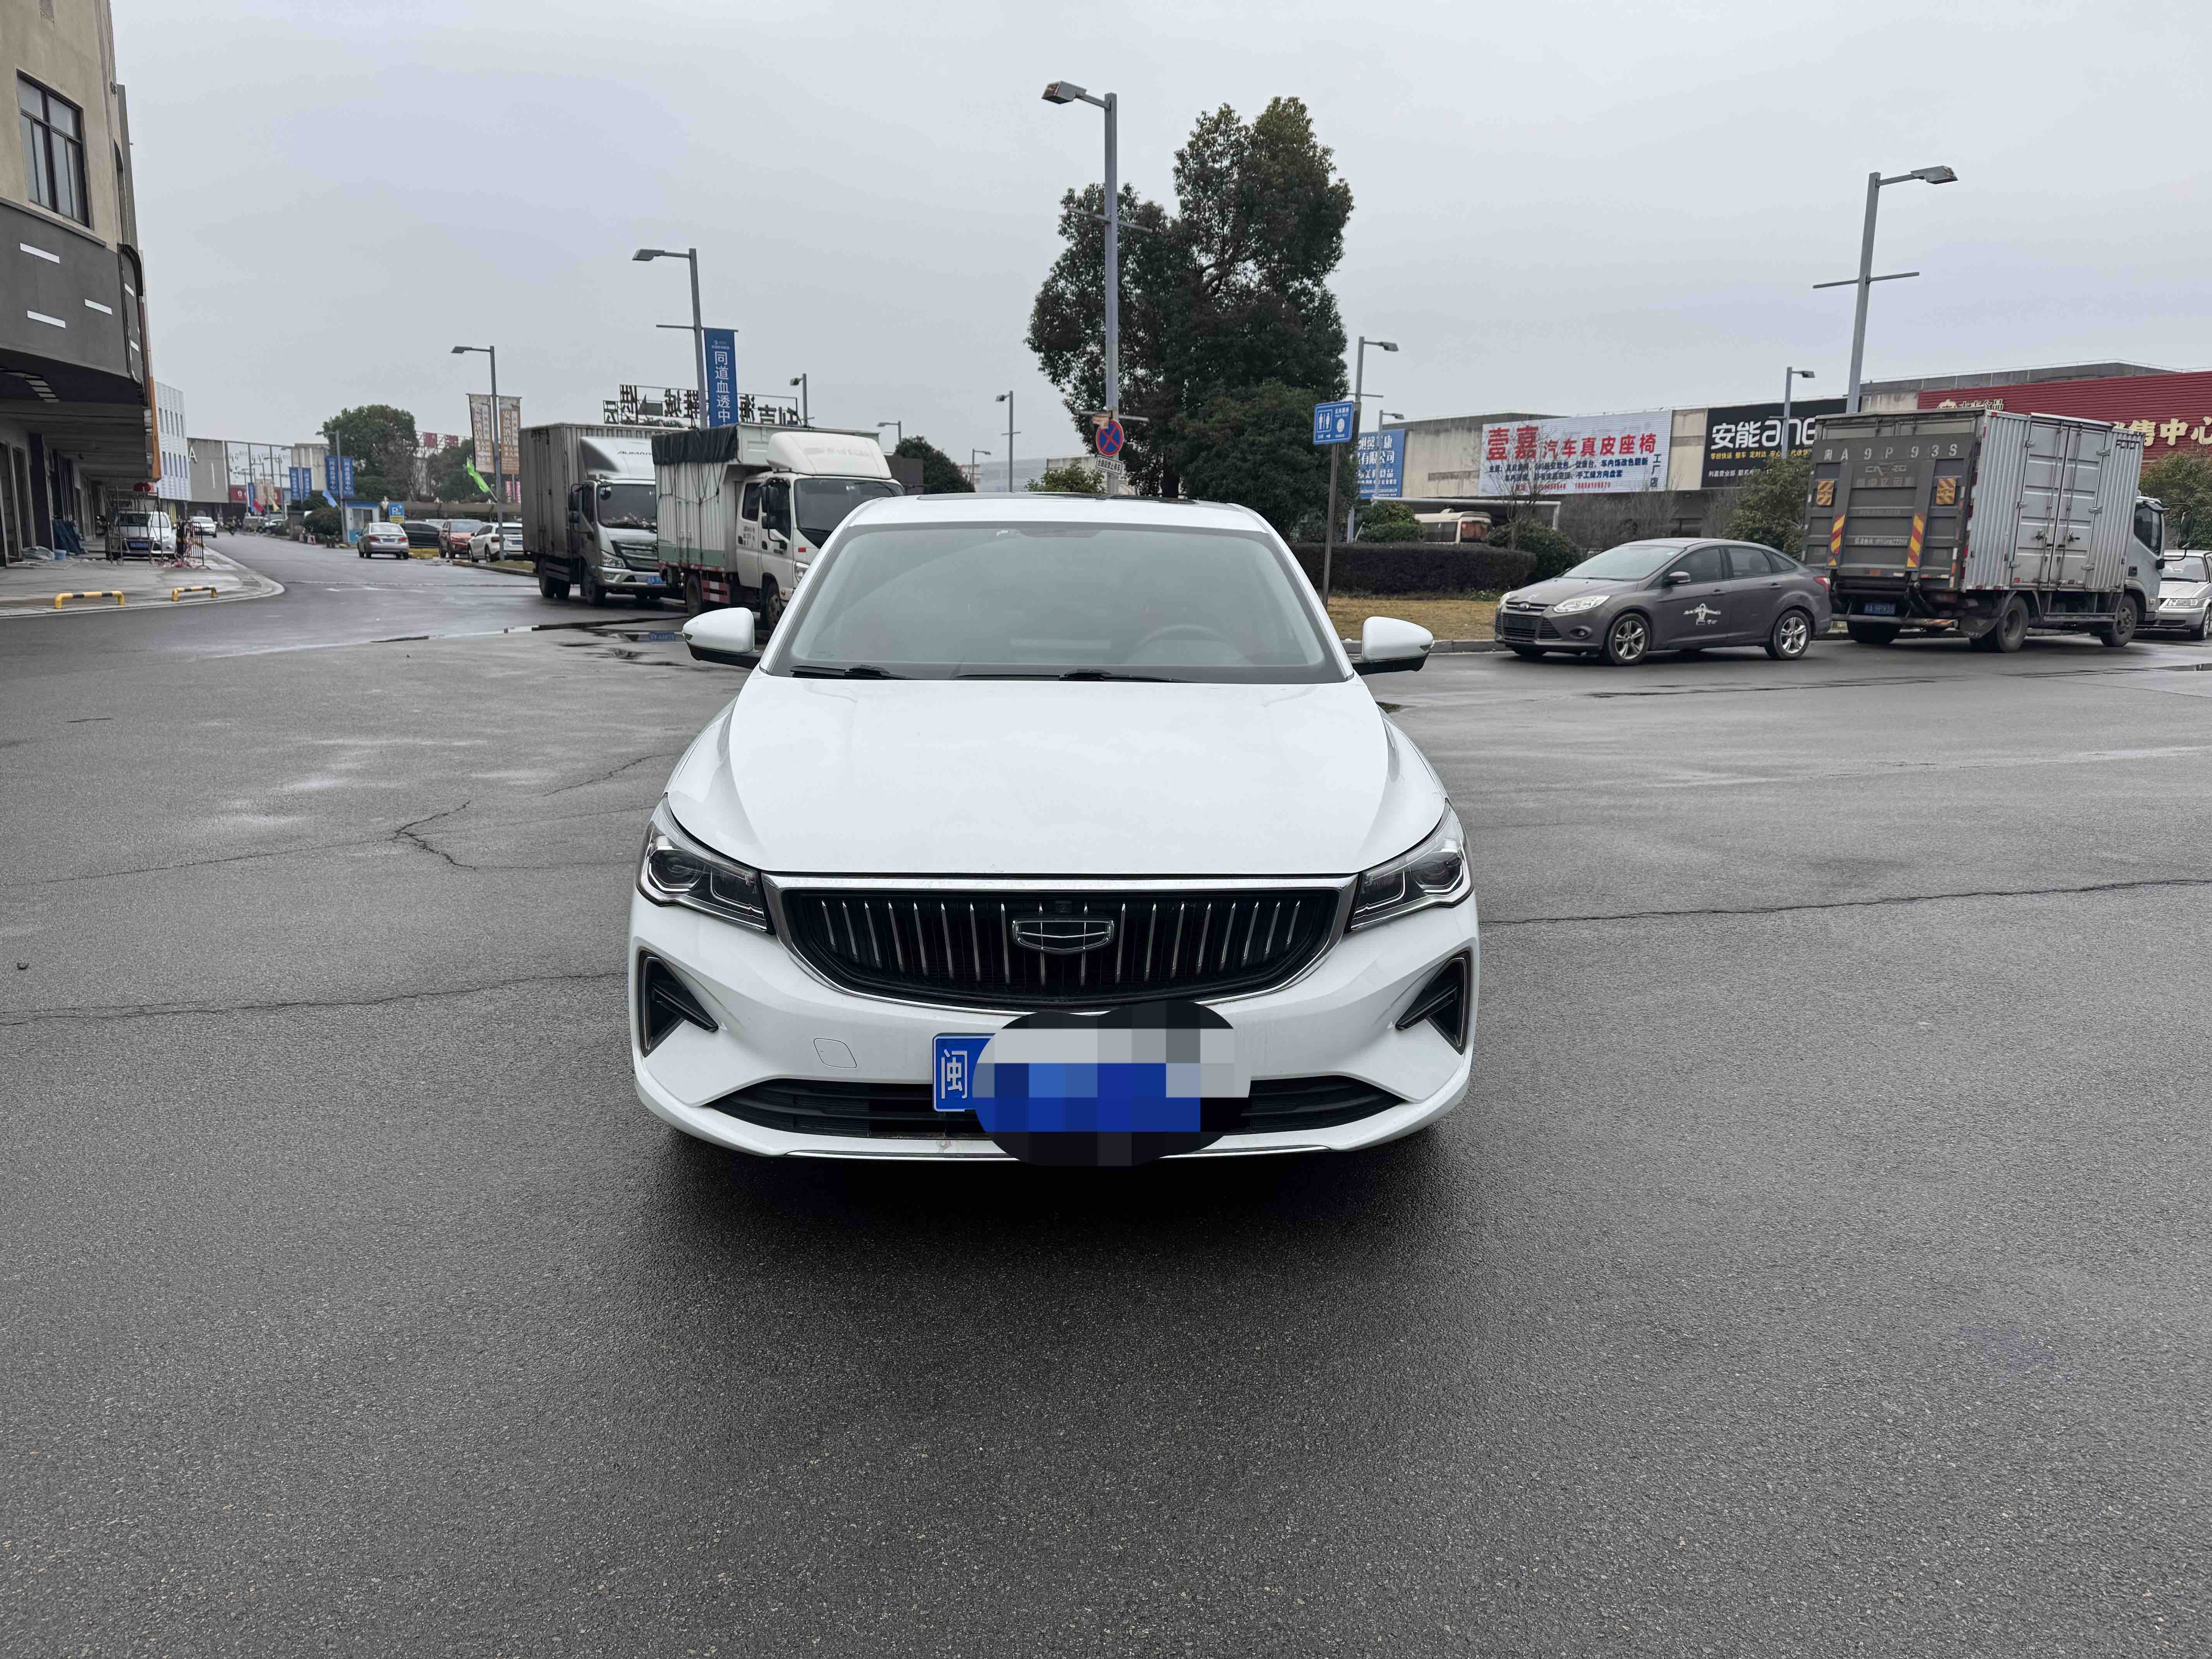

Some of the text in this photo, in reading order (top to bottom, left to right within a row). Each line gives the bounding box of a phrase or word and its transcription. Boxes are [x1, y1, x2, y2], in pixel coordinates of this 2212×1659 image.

[714, 350, 731, 424] 同道血透中
[1487, 426, 1539, 460] 壹嘉
[1542, 433, 1656, 459] 汽车真皮座椅
[1711, 421, 1761, 450] 安能
[2113, 416, 2212, 447] 售中心
[1649, 453, 1662, 487] 工厂店
